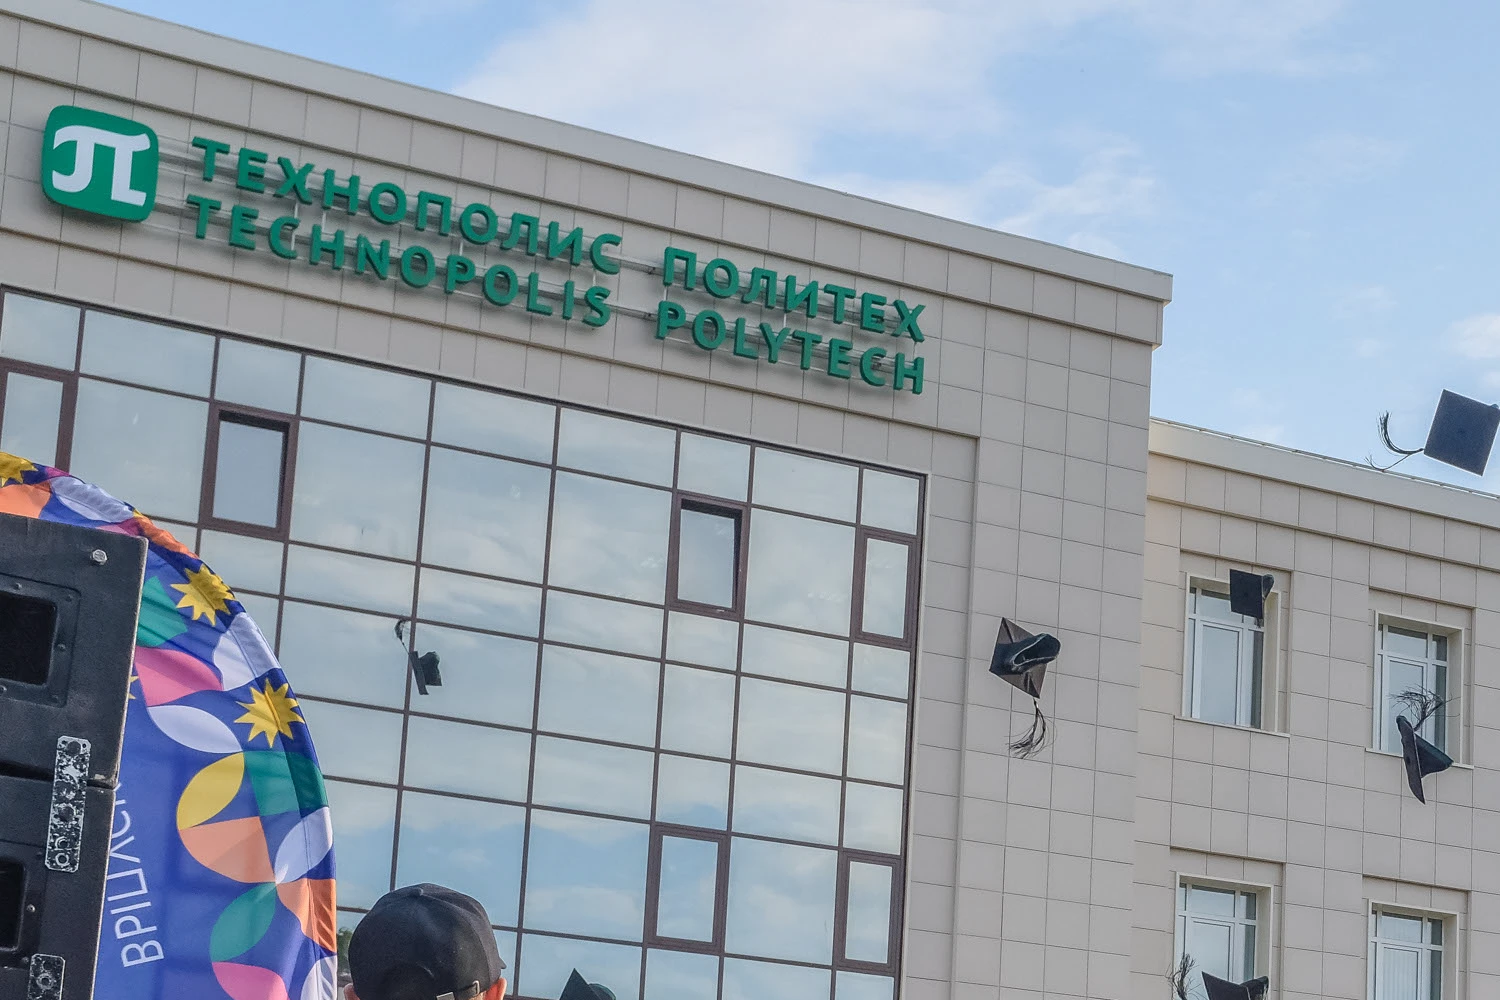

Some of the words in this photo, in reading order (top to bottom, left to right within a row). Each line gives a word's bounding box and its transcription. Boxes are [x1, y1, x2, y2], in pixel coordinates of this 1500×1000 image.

[186, 194, 612, 328] TECHNOPOLIS
[655, 300, 925, 395] POLYTECH
[192, 136, 622, 275] ТЕХНОПОЛИС
[663, 246, 926, 343] ПОЛИТЕХ
